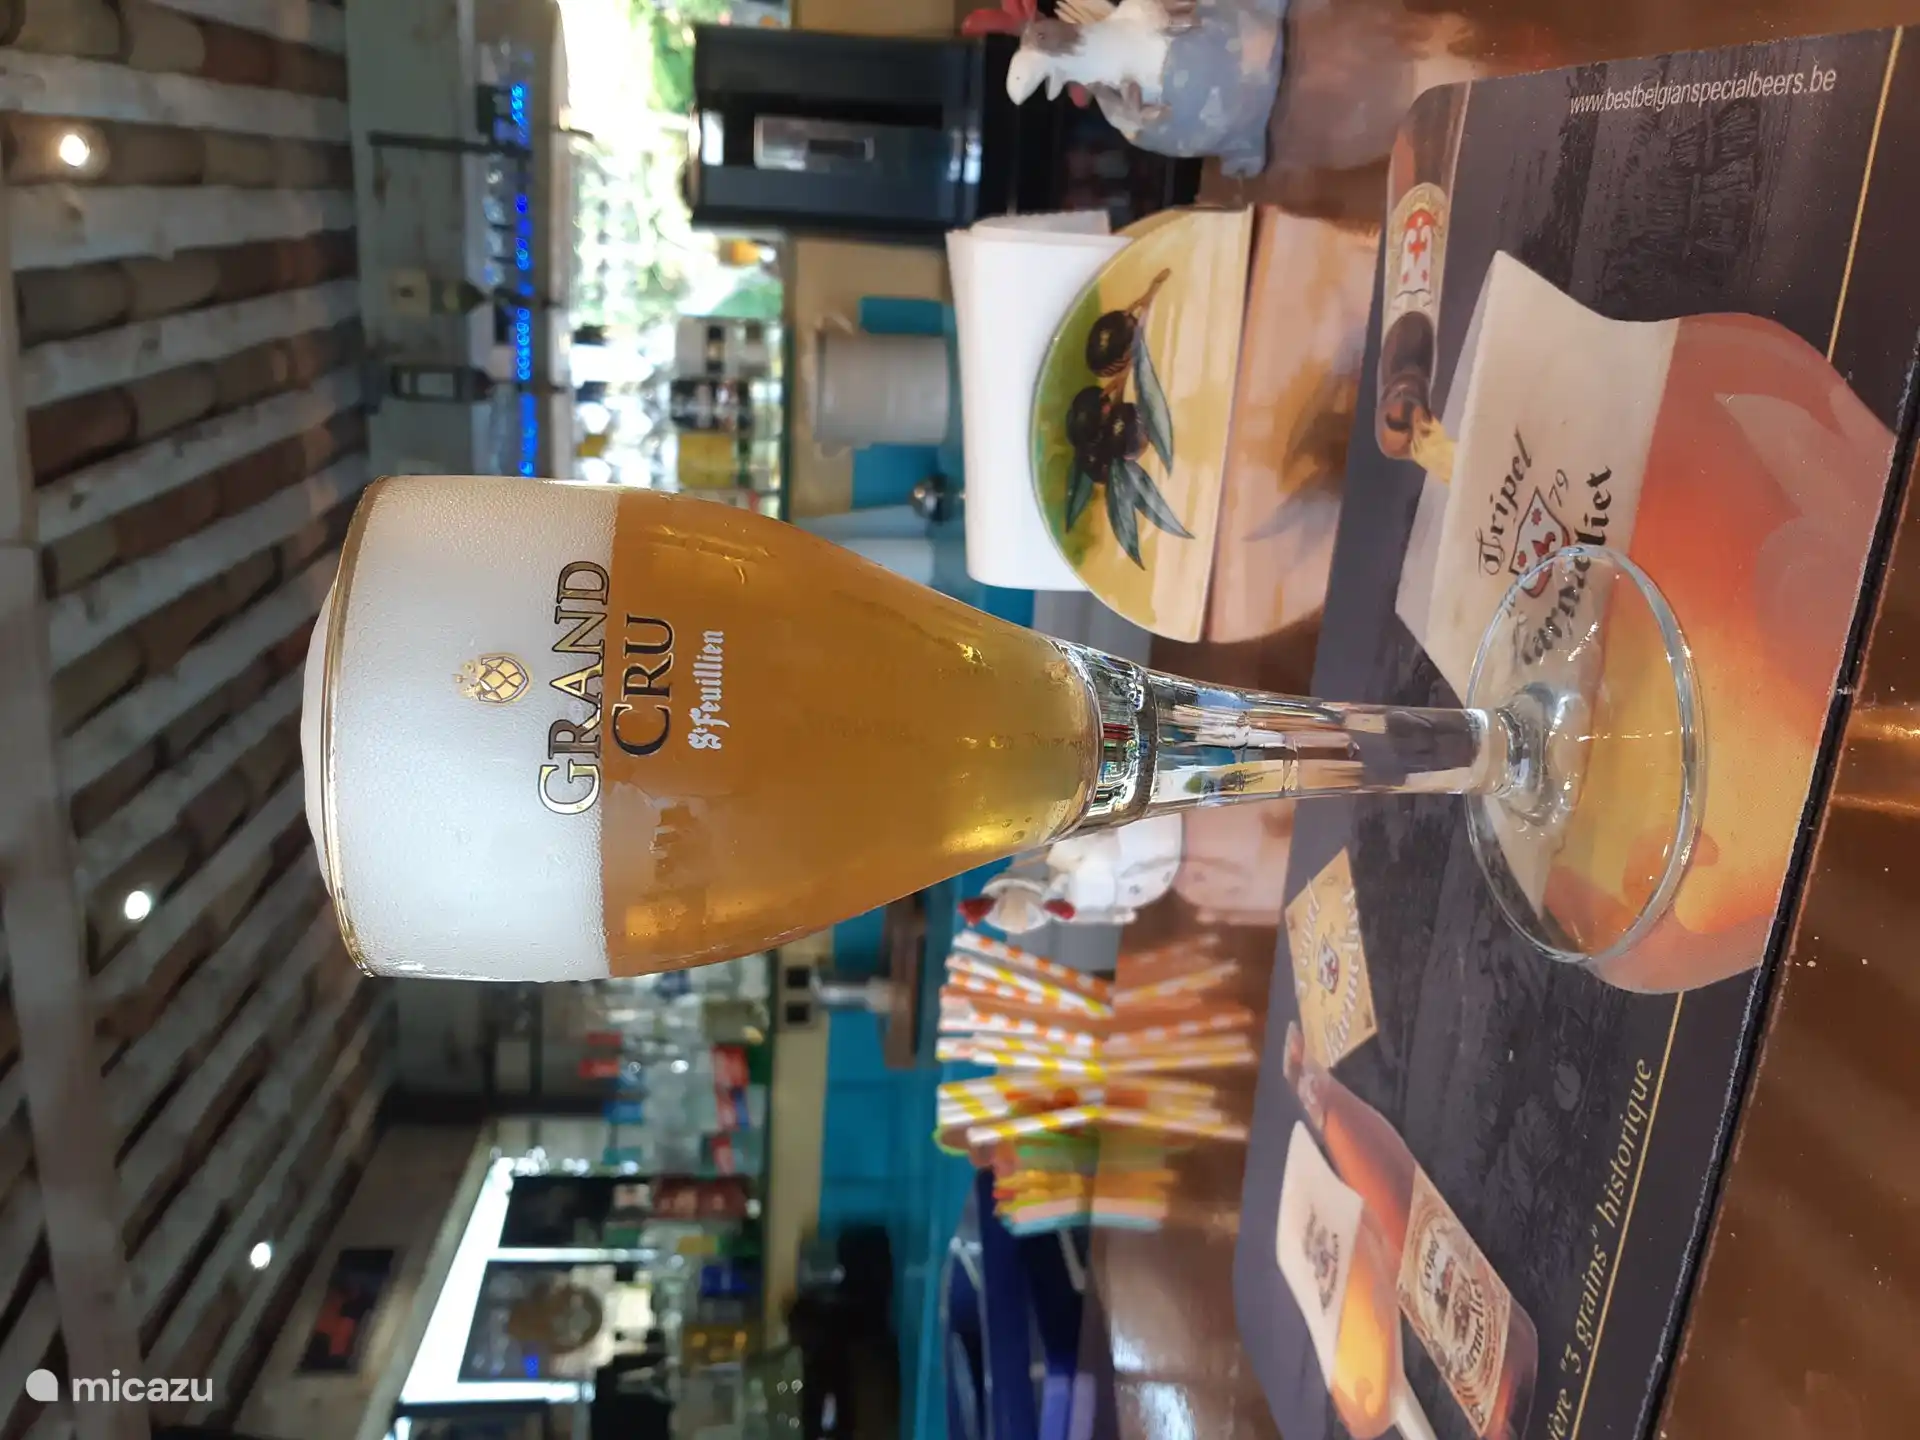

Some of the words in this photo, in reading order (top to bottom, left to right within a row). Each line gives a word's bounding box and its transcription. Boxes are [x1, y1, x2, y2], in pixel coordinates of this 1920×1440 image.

[1570, 65, 1837, 114] www.bestbelgianspecialbeers.be
[1475, 423, 1533, 577] Tripel
[1513, 465, 1612, 672] armeliet
[537, 560, 609, 816] GRAND
[612, 613, 675, 757] CRU
[1547, 1388, 1572, 1440] ière
[1596, 1059, 1652, 1228] historique
